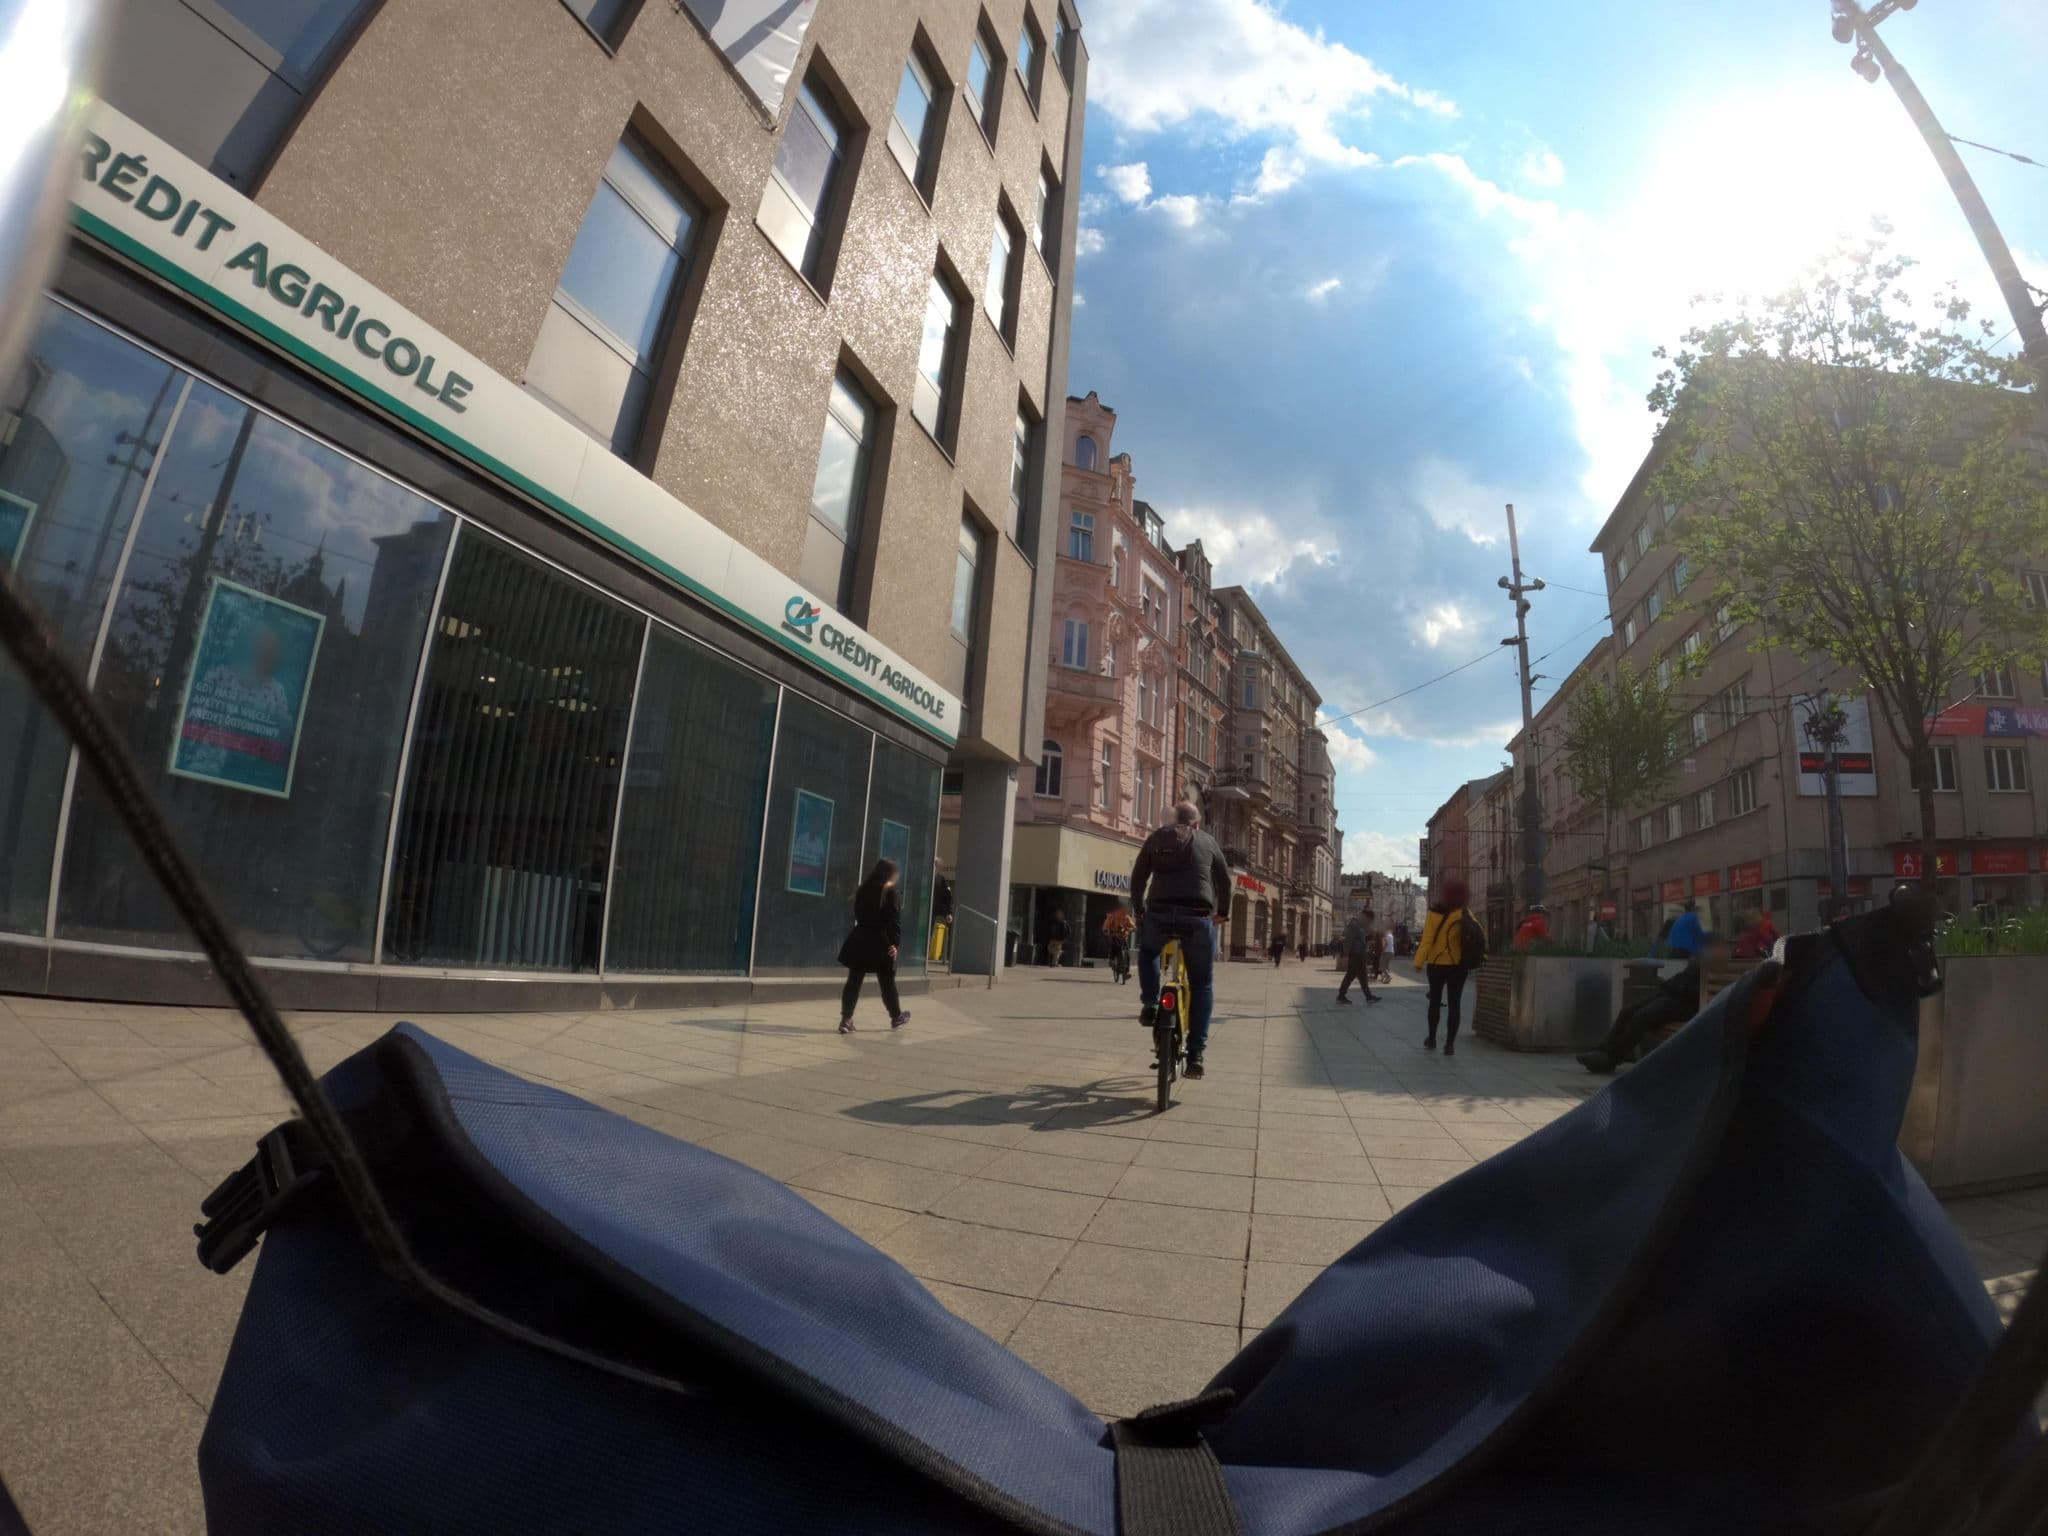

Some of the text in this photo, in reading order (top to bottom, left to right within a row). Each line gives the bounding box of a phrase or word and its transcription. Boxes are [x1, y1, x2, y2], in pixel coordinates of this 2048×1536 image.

[79, 130, 476, 414] RÉDIT AGRICOLE
[819, 624, 945, 719] CRÉDIT AGRICOLE
[1094, 868, 1132, 890] LAJKONI
